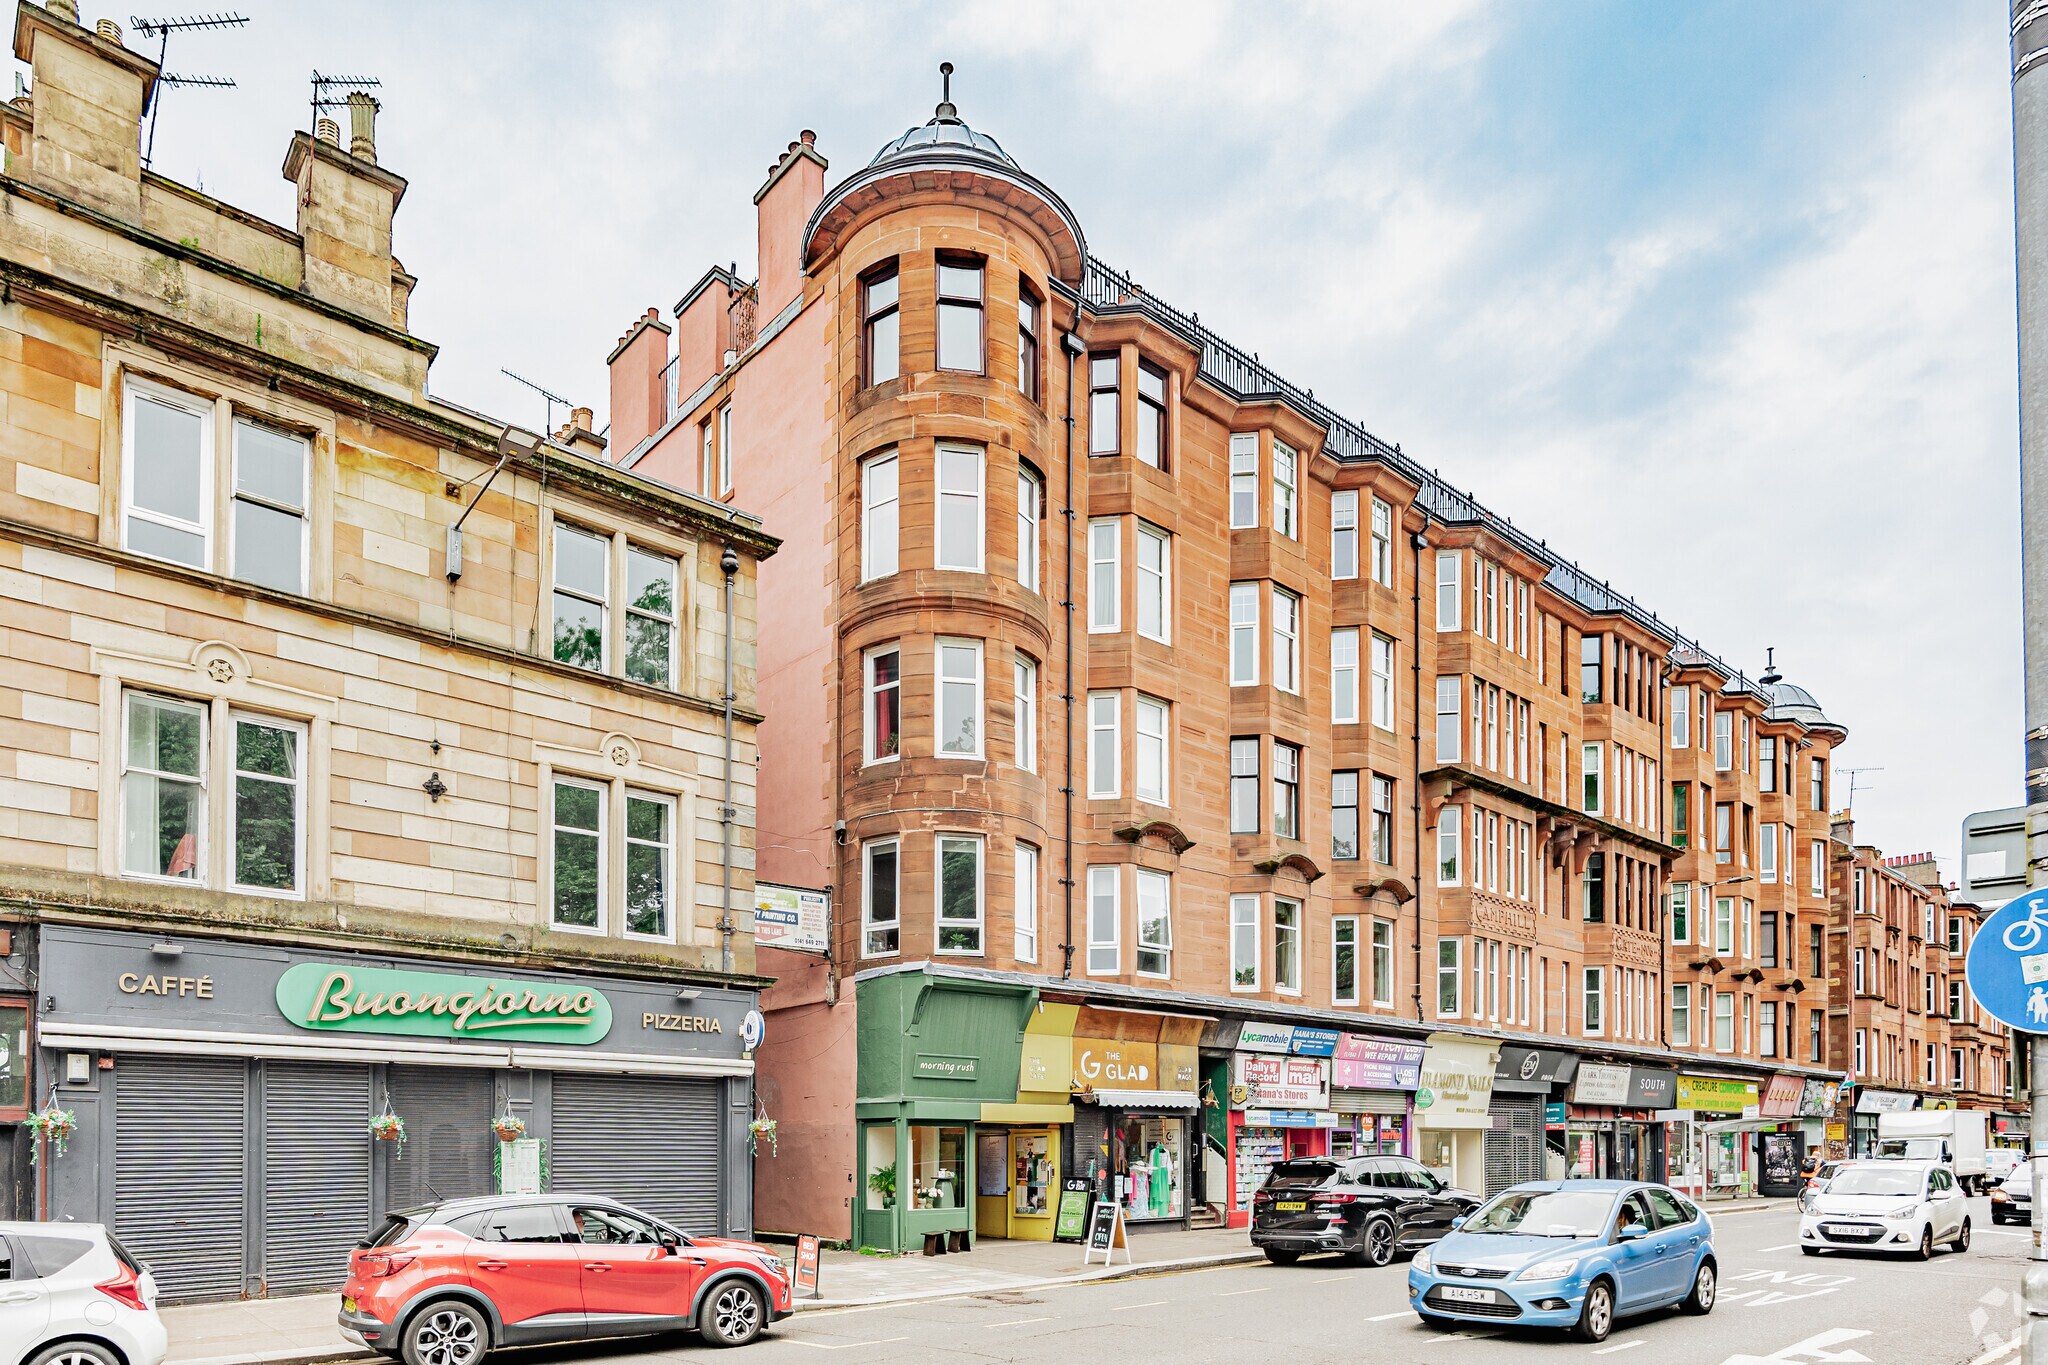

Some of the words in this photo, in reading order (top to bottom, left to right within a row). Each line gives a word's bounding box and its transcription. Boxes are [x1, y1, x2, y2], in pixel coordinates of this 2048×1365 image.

[762, 911, 786, 922] PRINTING
[1476, 902, 1530, 930] CAMPHILL
[118, 972, 214, 999] CAFFÉ
[306, 970, 597, 1030] Buongiorno
[641, 1012, 723, 1034] PIZZERIA
[1241, 1030, 1289, 1044] Lycamobile
[1294, 1030, 1316, 1039] RANA'S
[1316, 1032, 1338, 1040] STORES
[1106, 1052, 1120, 1060] THE
[1364, 1052, 1377, 1060] WEE
[1378, 1052, 1397, 1062] REPAIR
[1404, 1053, 1420, 1061] MARY
[920, 1062, 955, 1074] morning
[956, 1060, 975, 1072] rush
[1106, 1064, 1149, 1080] GLAD
[1246, 1062, 1270, 1074] Daily
[1290, 1064, 1314, 1074] sunday
[1400, 1068, 1416, 1076] LOST
[1246, 1071, 1279, 1082] Record
[1288, 1067, 1320, 1084] mail
[1466, 1074, 1493, 1092] NAILS
[1640, 1078, 1666, 1090] SOUTH
[1692, 1080, 1718, 1092] CREATURE
[1719, 1082, 1746, 1094] COMFORTS
[1284, 1090, 1308, 1100] Stores
[800, 1252, 816, 1260] SHOP
[1467, 1291, 1485, 1300] HSW
